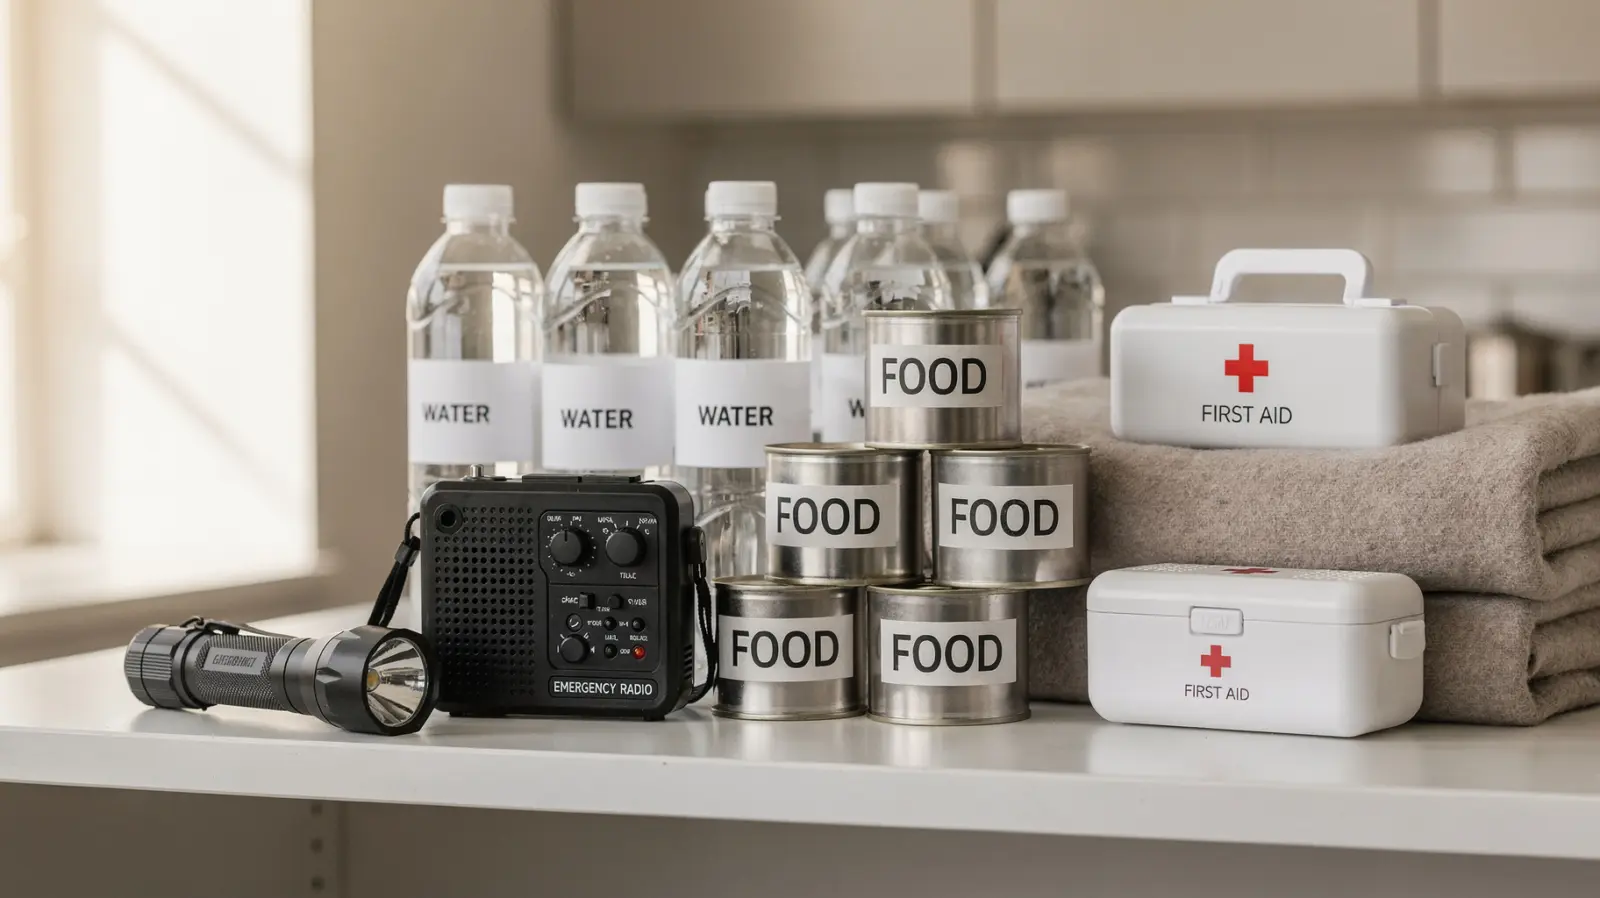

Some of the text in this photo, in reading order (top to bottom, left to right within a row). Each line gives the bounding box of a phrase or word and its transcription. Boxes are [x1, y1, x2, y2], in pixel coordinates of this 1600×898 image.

[881, 357, 988, 397] FOOD
[422, 403, 491, 424] WATER
[560, 408, 634, 430] WATER
[698, 405, 775, 427] WATER
[1201, 404, 1293, 425] FIRST AID
[776, 496, 881, 537] FOOD
[951, 497, 1060, 538] FOOD
[731, 628, 840, 669] FOOD
[892, 633, 1003, 674] FOOD
[553, 680, 653, 696] EMERGENCY RADIO
[1184, 683, 1250, 701] FIRST AID
